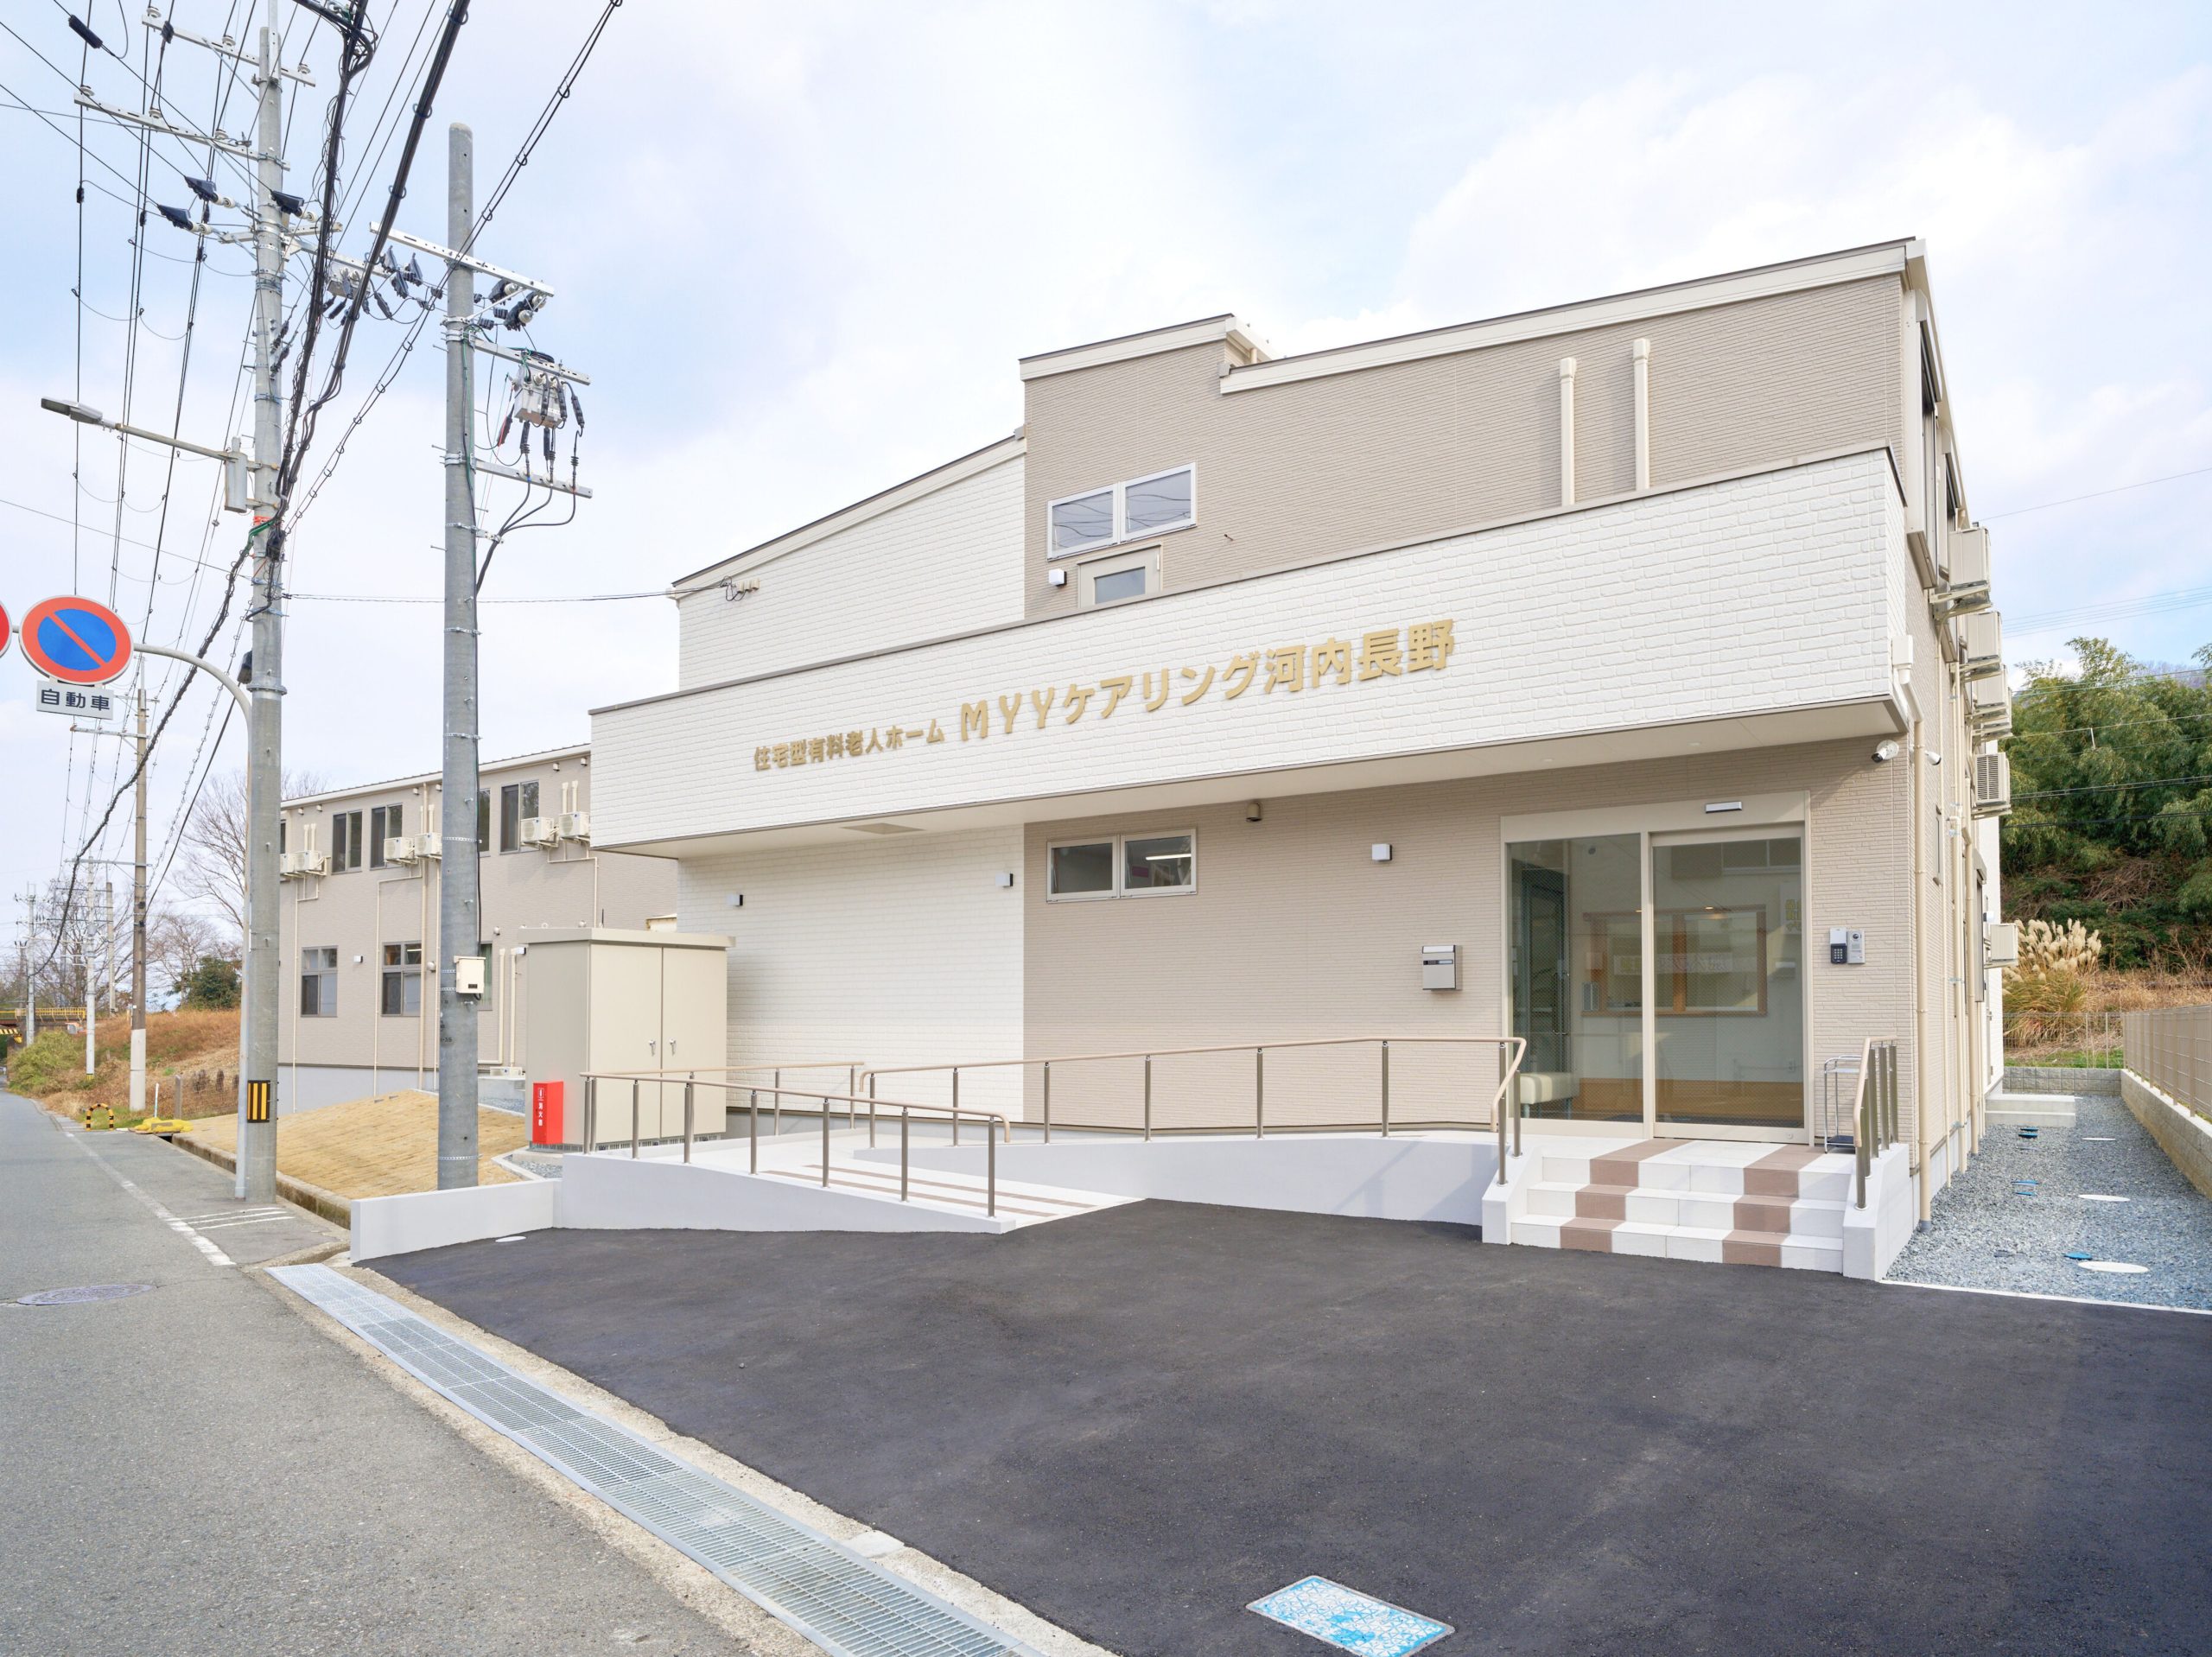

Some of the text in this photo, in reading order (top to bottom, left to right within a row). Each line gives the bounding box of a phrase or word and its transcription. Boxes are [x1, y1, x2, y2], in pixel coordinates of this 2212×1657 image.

[41, 688, 111, 711] 自動車
[753, 619, 1455, 771] 住宅型有料老人ホーム MYYケアリング河内長野
